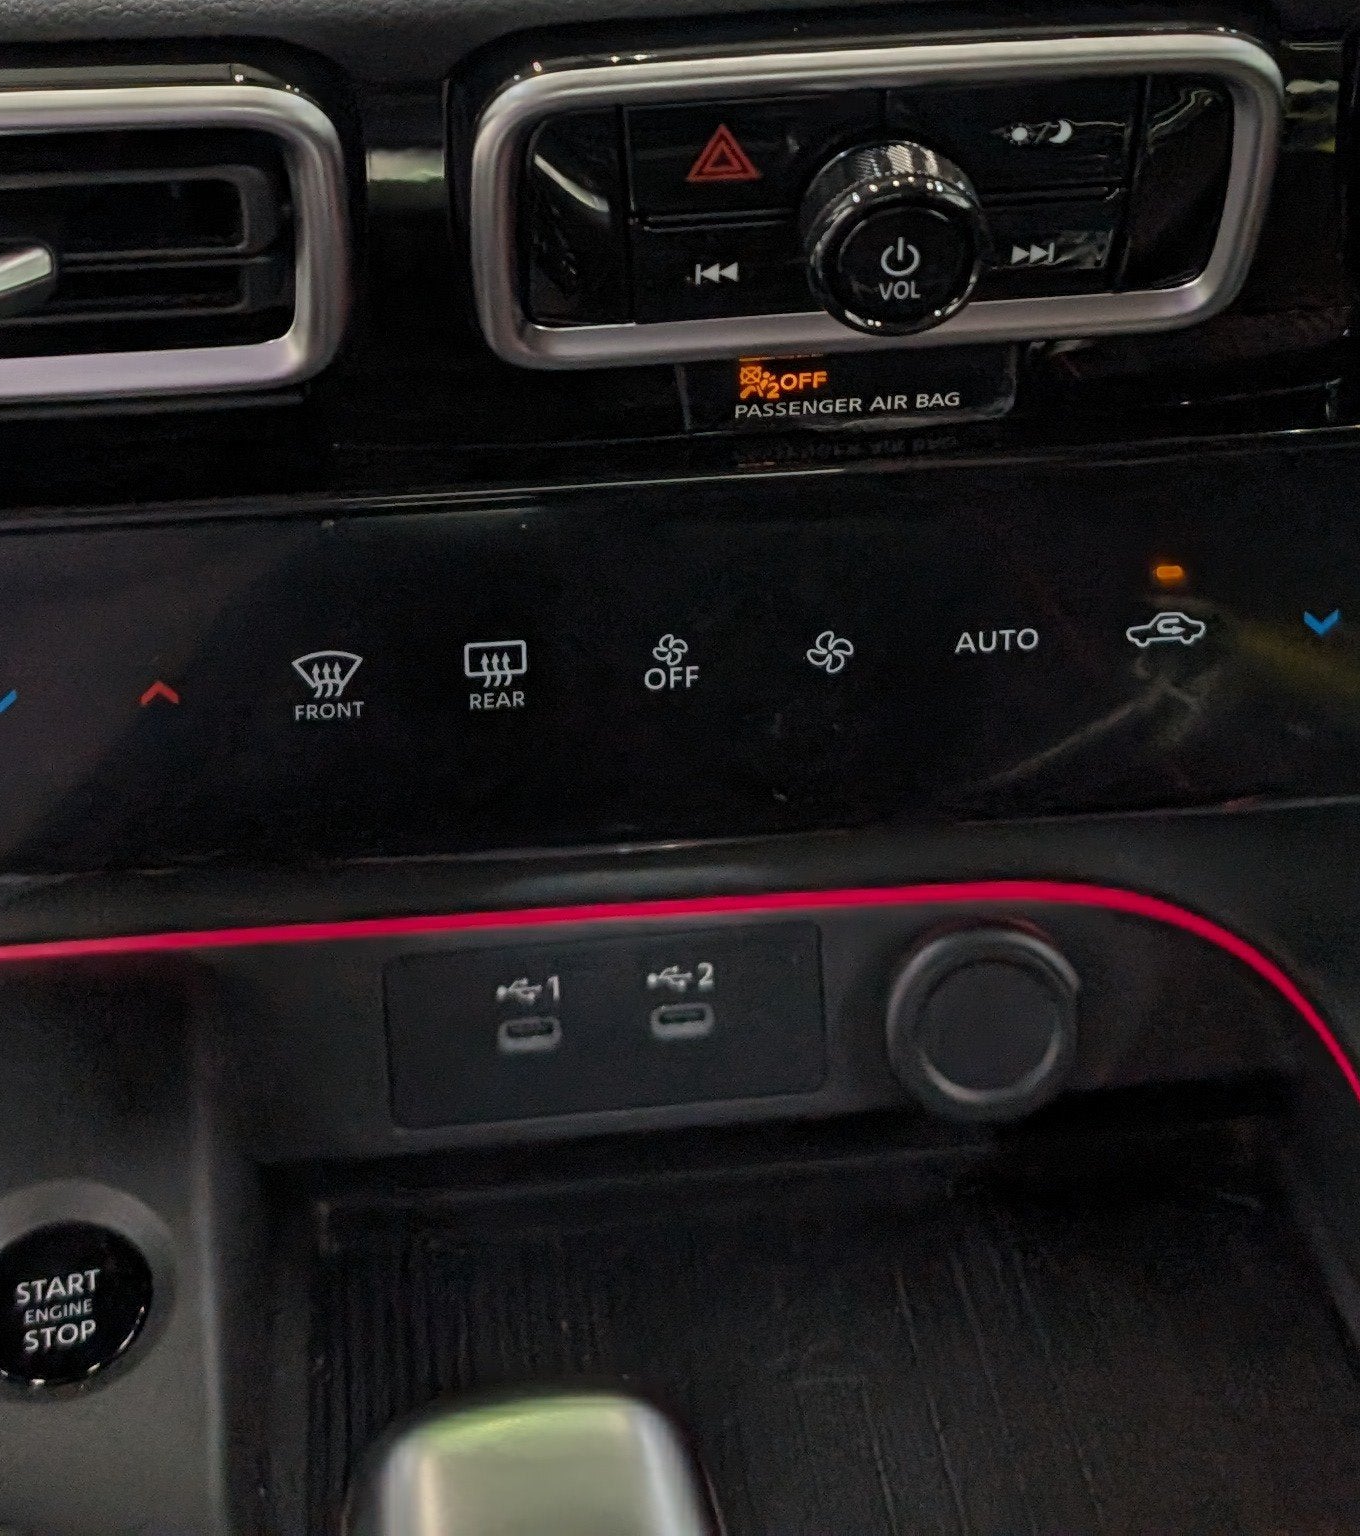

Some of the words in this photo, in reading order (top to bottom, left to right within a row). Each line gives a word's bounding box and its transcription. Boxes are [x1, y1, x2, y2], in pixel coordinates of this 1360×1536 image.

[879, 279, 922, 302] VOL
[780, 370, 828, 391] OFF
[734, 397, 863, 419] PASSENGER
[869, 394, 908, 412] AIR
[915, 391, 961, 409] BAG
[955, 628, 1040, 655] AUTO
[644, 666, 700, 691] OFF
[294, 700, 365, 722] FRONT
[468, 689, 526, 710] REAR
[698, 962, 714, 990] 2
[15, 1268, 101, 1305] START
[24, 1298, 93, 1325] ENGINE
[23, 1319, 97, 1352] STOP
